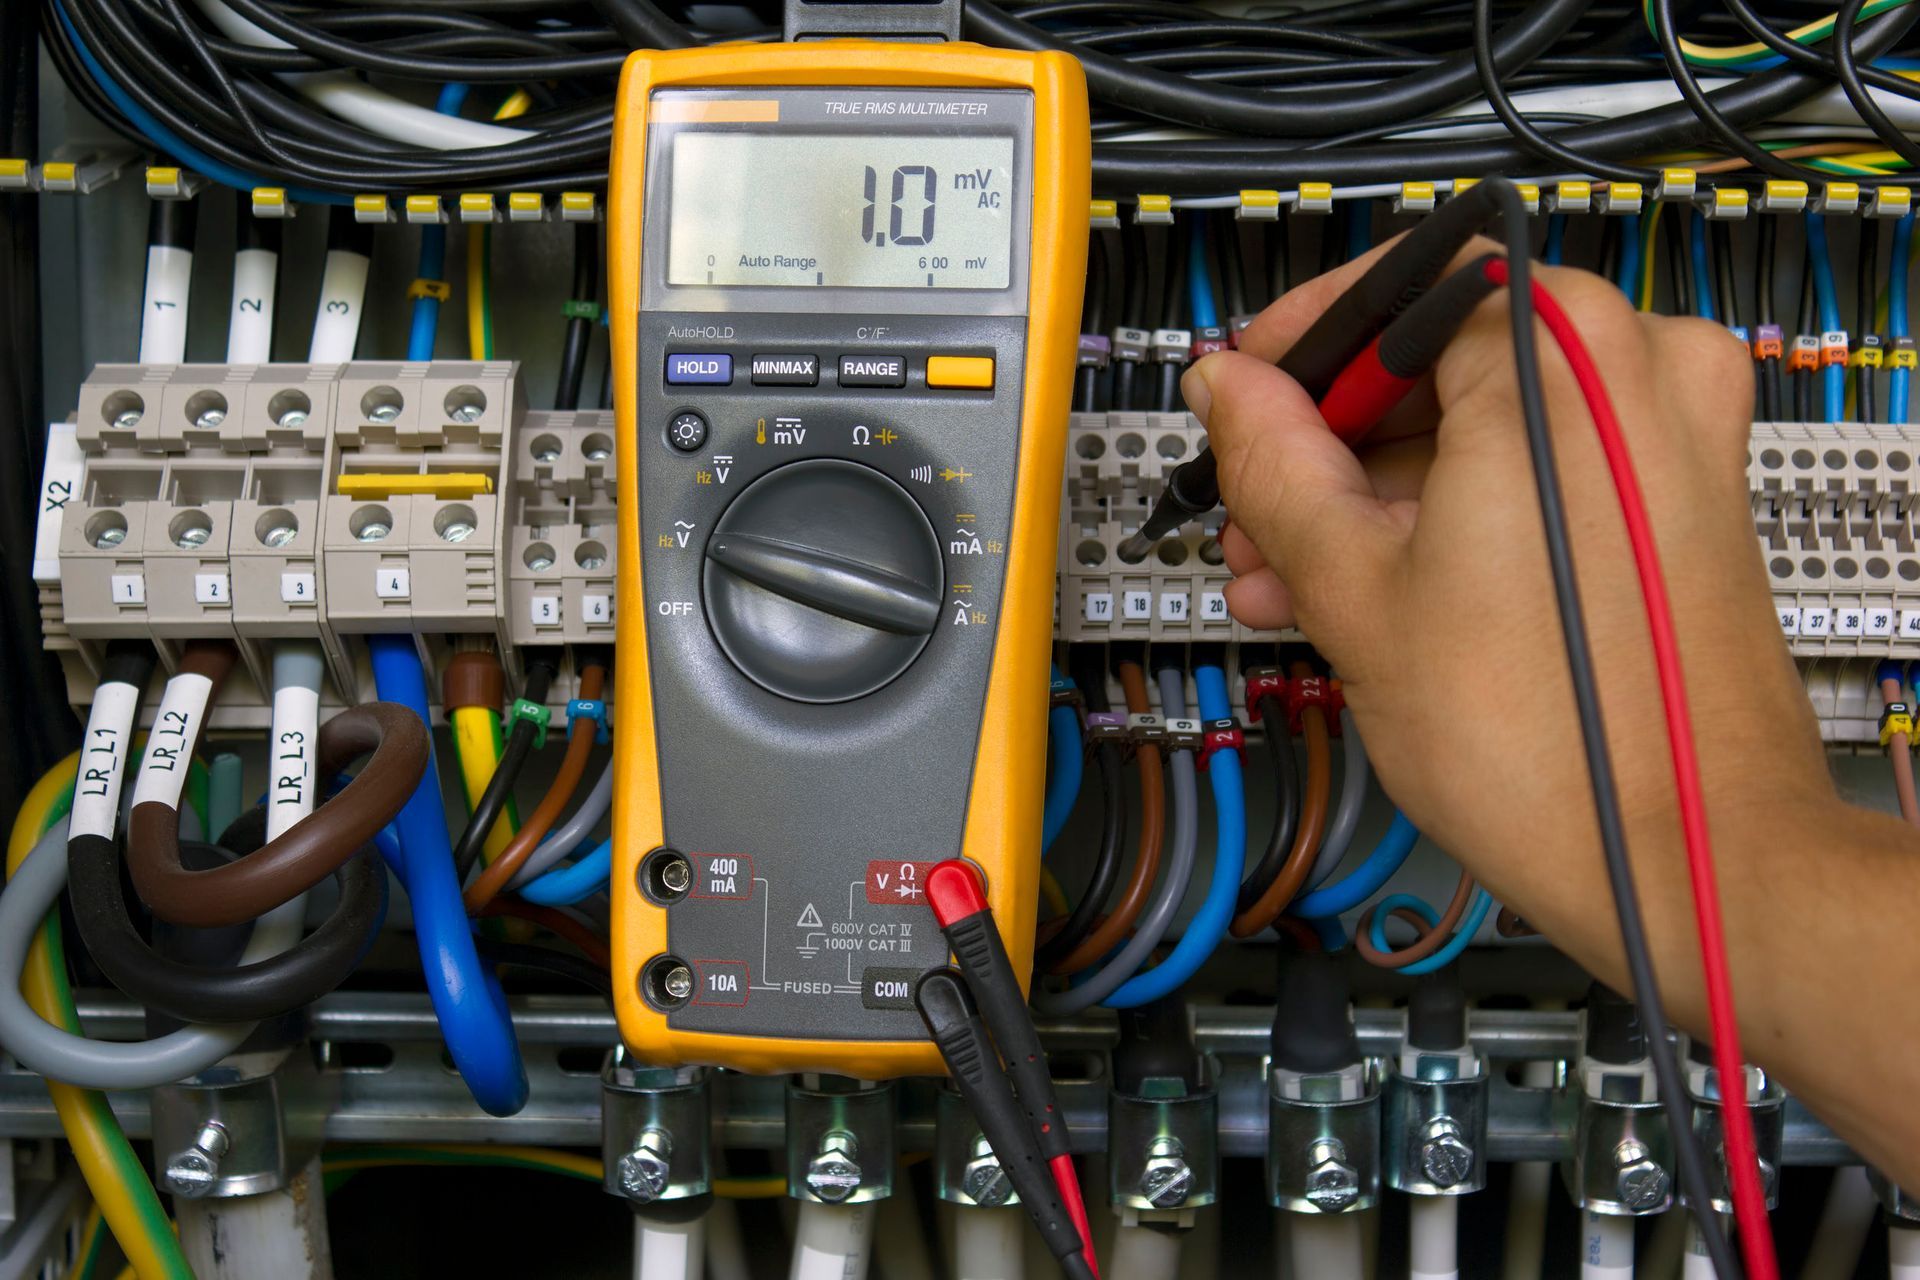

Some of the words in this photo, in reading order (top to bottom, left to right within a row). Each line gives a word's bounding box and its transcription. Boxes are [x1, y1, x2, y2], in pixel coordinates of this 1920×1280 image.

[824, 102, 862, 115] TRUE
[864, 102, 896, 115] RMS
[898, 102, 988, 116] MULTIMETER
[954, 168, 992, 190] mV
[861, 165, 938, 247] 1.0
[977, 192, 1000, 209] AC
[707, 256, 715, 267] 0
[739, 254, 772, 268] Auto
[774, 255, 817, 270] Range
[965, 256, 987, 268] mV
[154, 301, 176, 311] 1
[240, 299, 262, 313] 2
[327, 301, 349, 315] 3
[668, 326, 734, 339] AutoHOLD
[677, 361, 719, 374] HOLD
[753, 361, 813, 375] MINMAX
[844, 362, 898, 376] RANGE
[774, 429, 806, 444] mV
[697, 472, 712, 484] Hz
[716, 468, 730, 483] V
[46, 480, 72, 513] X2
[659, 535, 673, 548] Hz
[677, 532, 691, 548] V
[951, 539, 983, 555] mA
[988, 541, 1003, 553] Hz
[126, 583, 133, 597] 1
[210, 582, 218, 596] 2
[296, 582, 304, 596] 3
[390, 578, 399, 591] 4
[543, 603, 549, 618] 5
[593, 602, 601, 616] 6
[659, 602, 693, 616] OFF
[1095, 601, 1108, 614] 17
[1134, 599, 1146, 611] 18
[1170, 600, 1182, 613] 19
[1210, 600, 1224, 613] 20
[954, 610, 968, 625] A
[972, 612, 987, 624] Hz
[1782, 615, 1794, 627] 36
[1811, 615, 1824, 628] 37
[1846, 615, 1859, 628] 38
[1875, 616, 1887, 628] 39
[521, 704, 539, 715] 5
[577, 702, 594, 710] 6
[149, 711, 189, 771] LR_L2
[82, 729, 117, 797] LR_L1
[277, 731, 308, 805] LR_L3
[710, 859, 738, 875] 400
[711, 878, 736, 893] mA
[876, 874, 890, 890] V
[831, 923, 863, 935] 600V
[868, 924, 896, 936] CAT
[824, 939, 863, 950] 1000V
[868, 939, 896, 951] CAT
[709, 975, 738, 992] 10A
[784, 981, 832, 995] FUSED
[875, 982, 908, 998] COM
